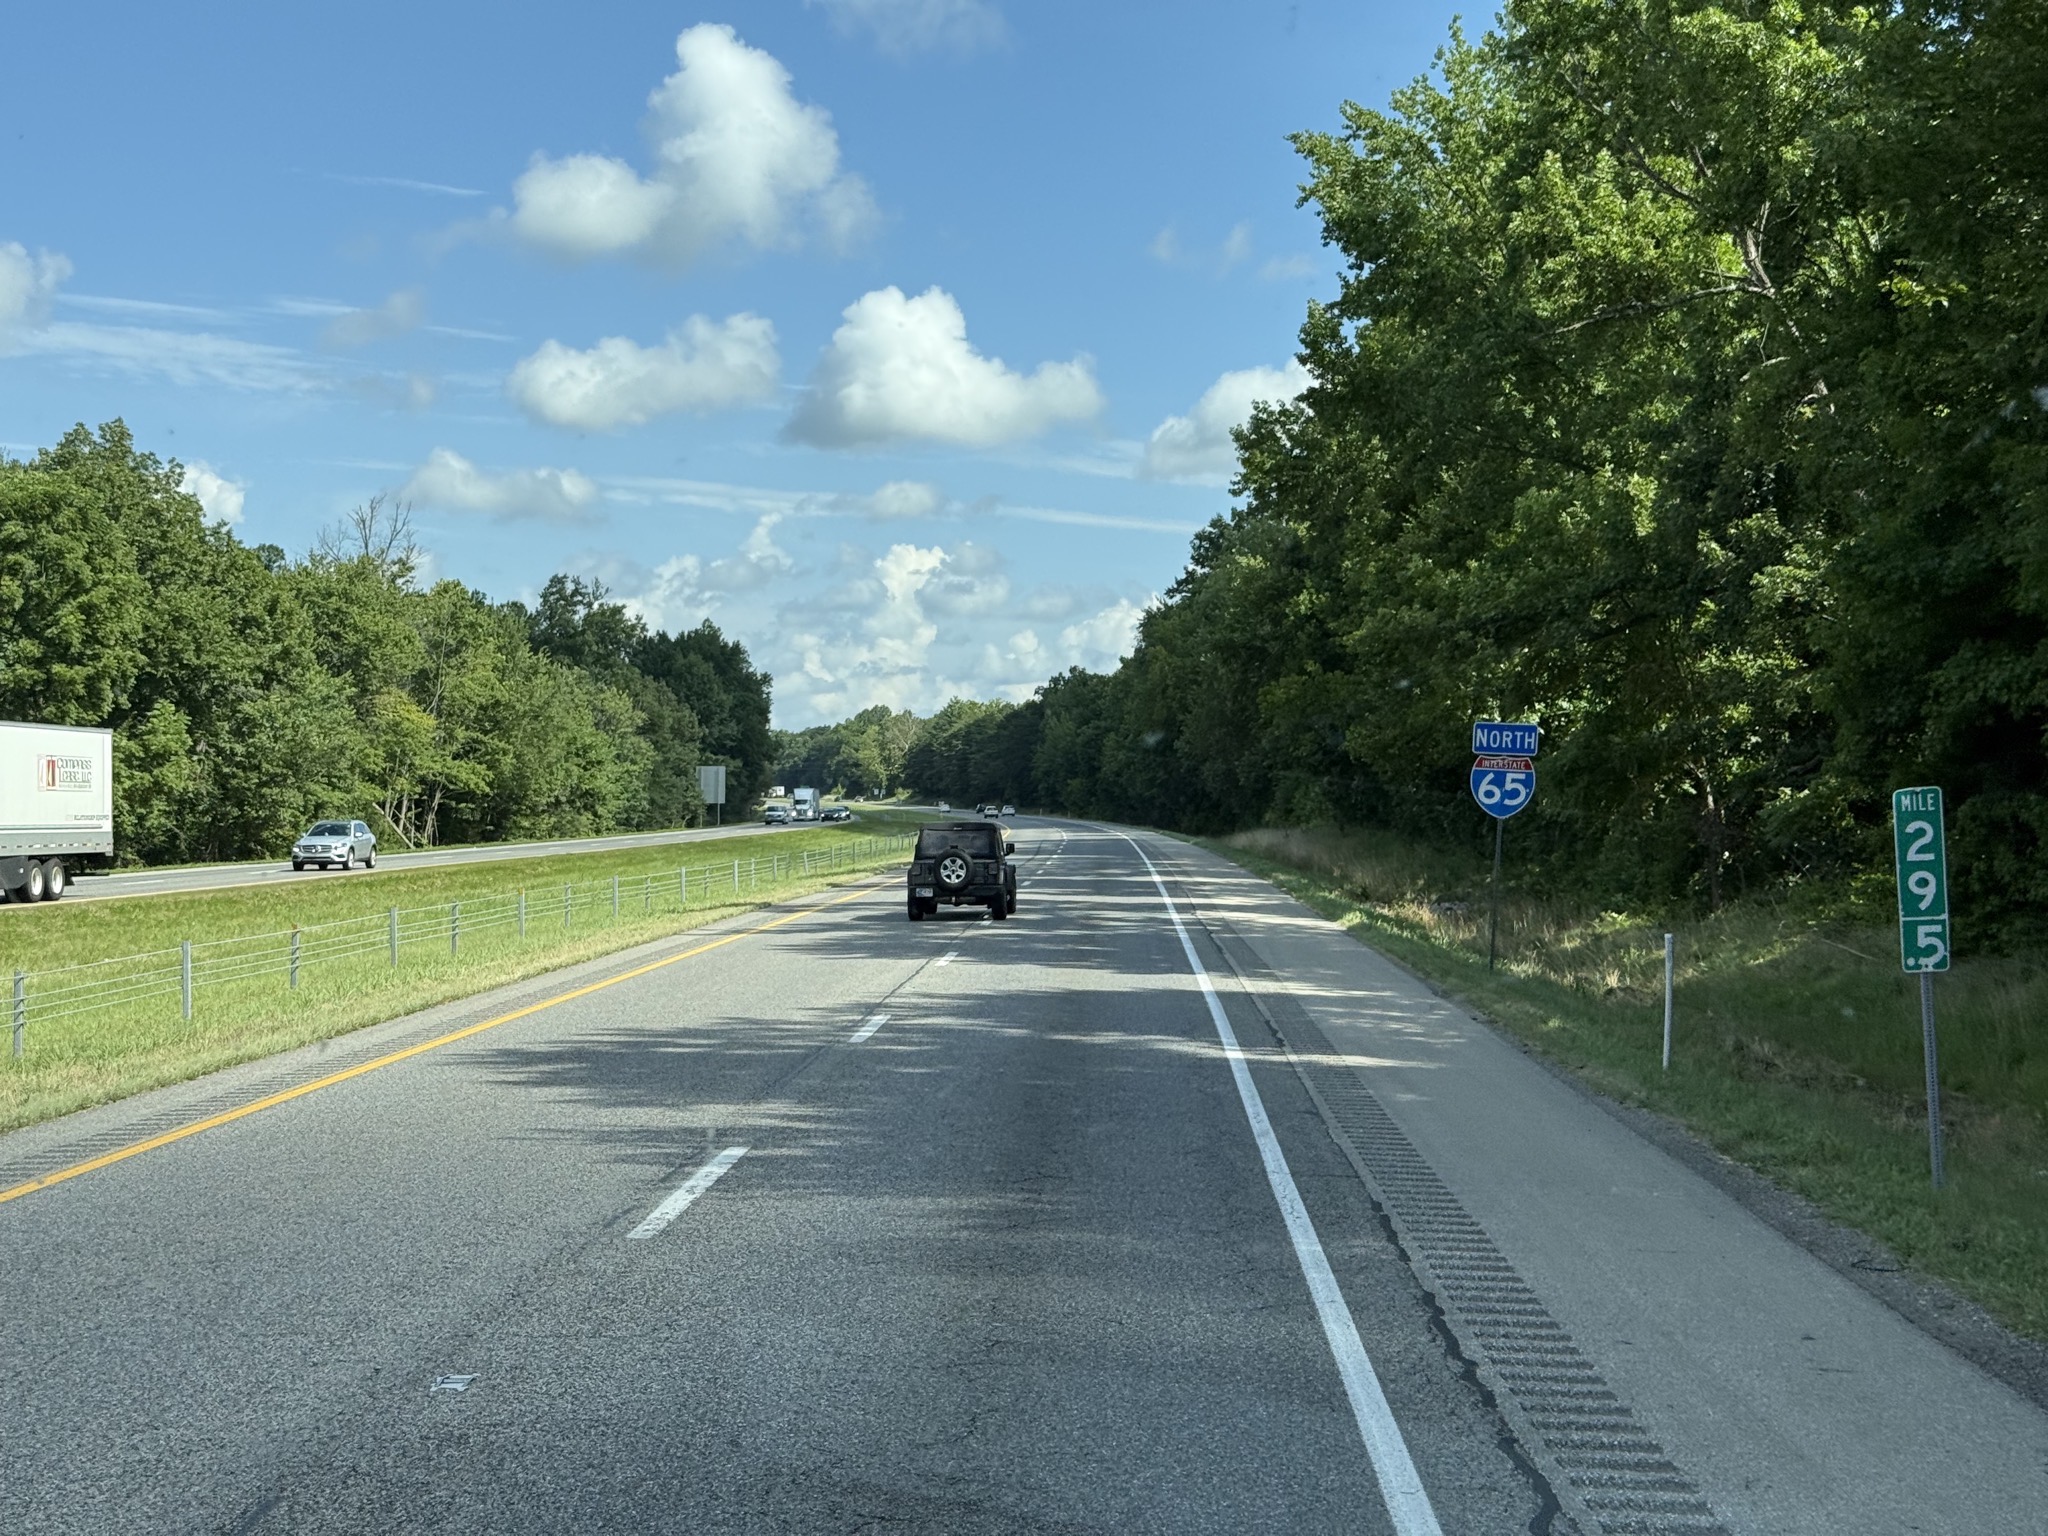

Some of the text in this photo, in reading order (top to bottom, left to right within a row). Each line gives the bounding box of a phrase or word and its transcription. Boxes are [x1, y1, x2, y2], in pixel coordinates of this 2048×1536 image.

[1475, 728, 1535, 749] NORTH
[1482, 760, 1526, 770] INTERSTATE
[1478, 772, 1526, 806] 65
[1901, 793, 1935, 811] MILE
